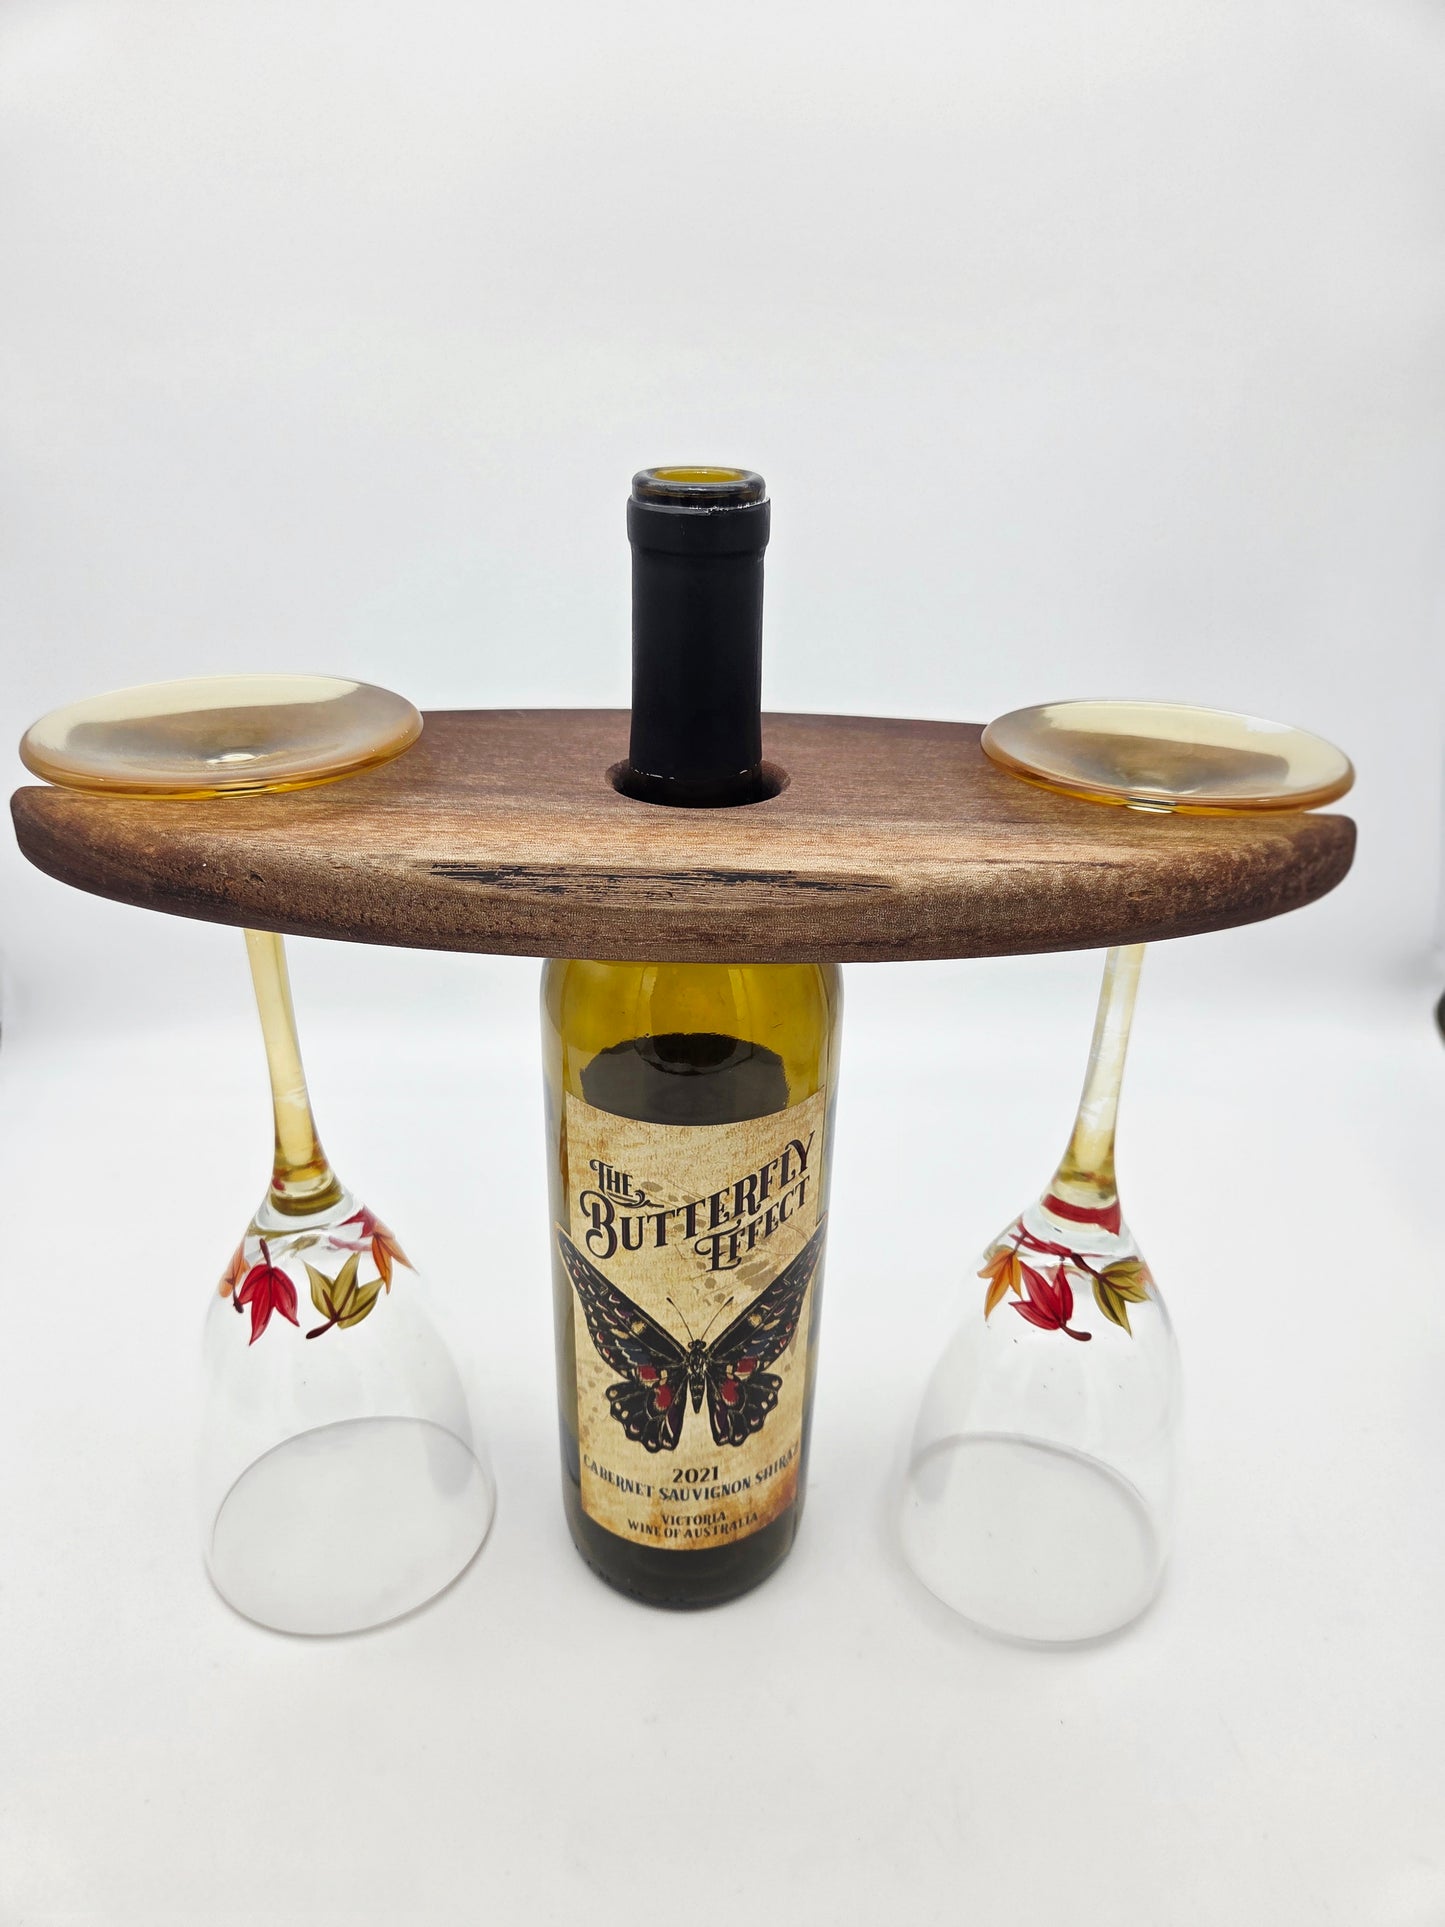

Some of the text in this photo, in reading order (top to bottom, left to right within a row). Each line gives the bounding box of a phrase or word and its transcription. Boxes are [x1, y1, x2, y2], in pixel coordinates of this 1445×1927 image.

[580, 1131, 815, 1260] BUTTERFLY
[589, 1158, 646, 1207] THE
[694, 1176, 810, 1272] EFFECT
[583, 1453, 656, 1498] CABERNET
[658, 1475, 751, 1502] SAUVIGNON
[672, 1466, 719, 1484] 2021
[627, 1512, 758, 1539] WINE OF AUSTRALIA
[661, 1511, 726, 1526] VICTORIA
